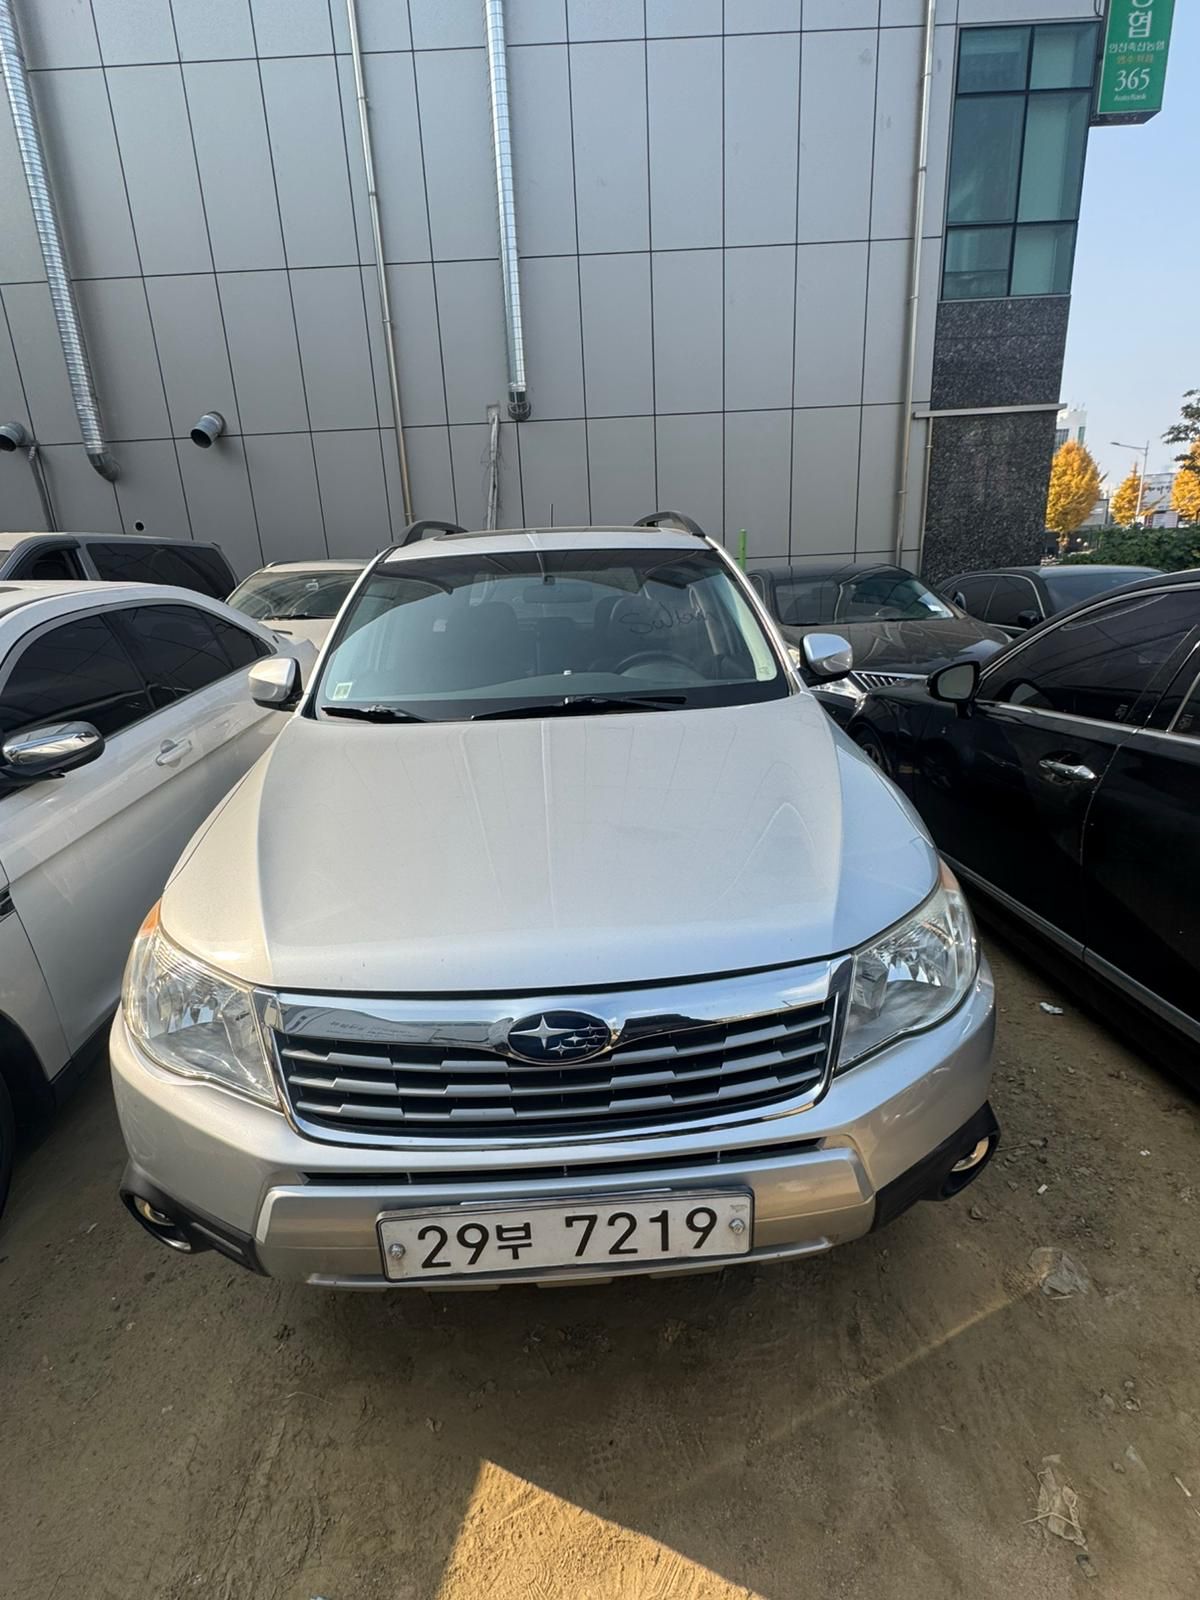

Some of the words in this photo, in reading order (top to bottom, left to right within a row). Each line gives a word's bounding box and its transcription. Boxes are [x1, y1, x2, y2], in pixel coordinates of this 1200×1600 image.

[1114, 67, 1151, 92] 365
[416, 1222, 533, 1269] 29부
[565, 1206, 718, 1257] 7219
